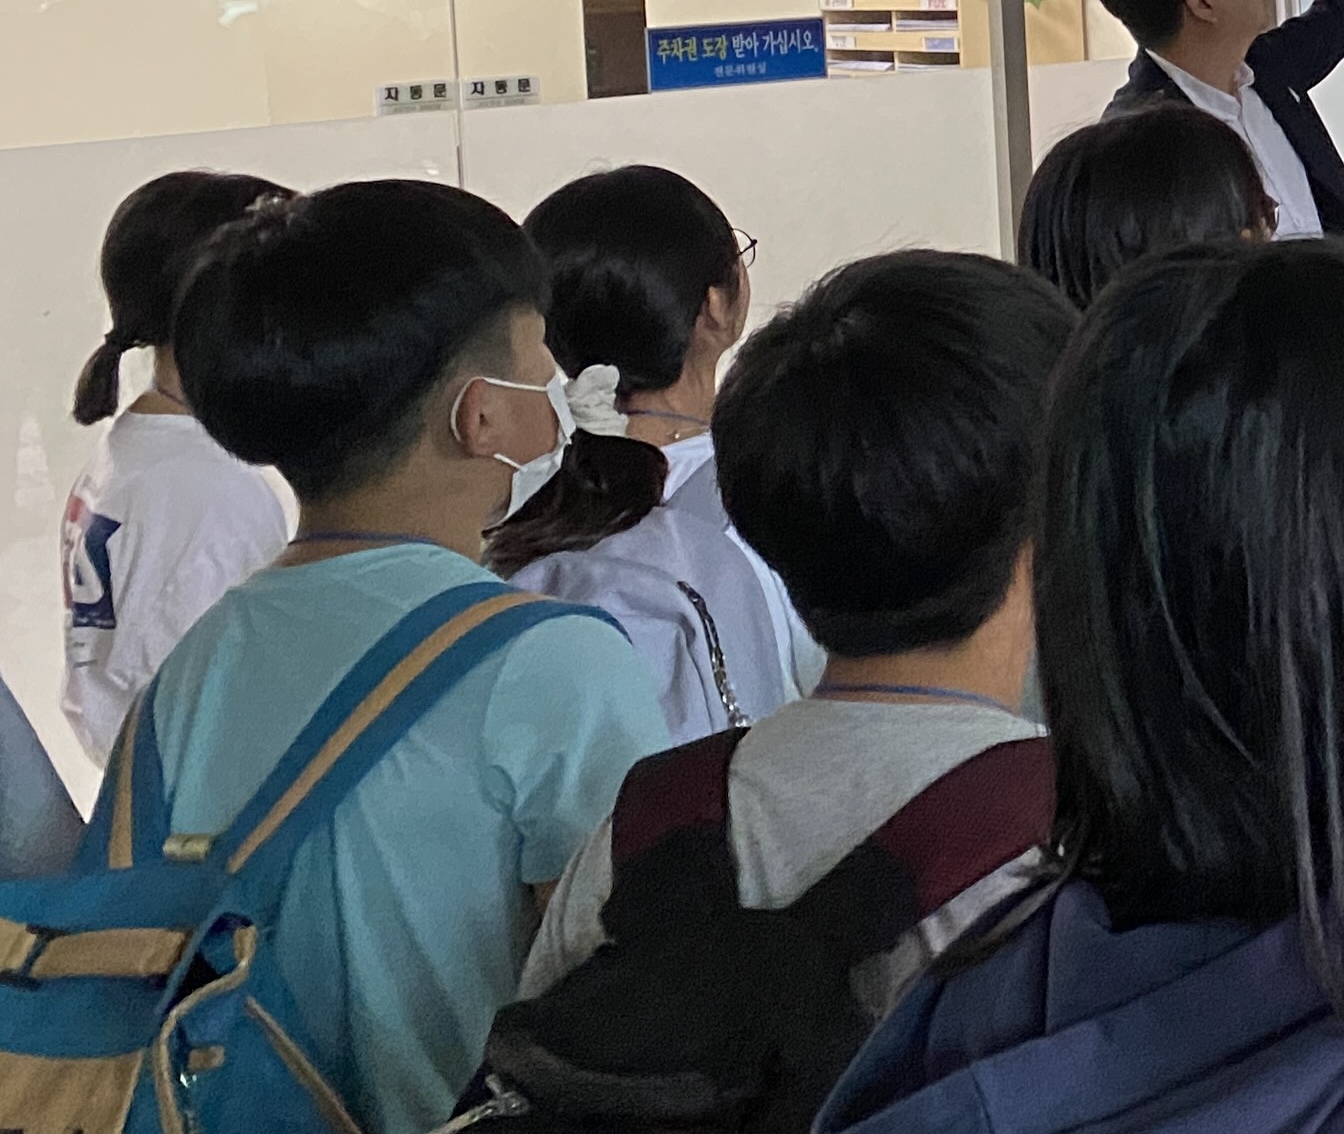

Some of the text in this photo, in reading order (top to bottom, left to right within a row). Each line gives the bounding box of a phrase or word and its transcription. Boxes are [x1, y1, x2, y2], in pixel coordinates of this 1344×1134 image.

[657, 36, 698, 64] 주차권
[702, 34, 727, 60] 도장
[732, 32, 760, 59] 받아
